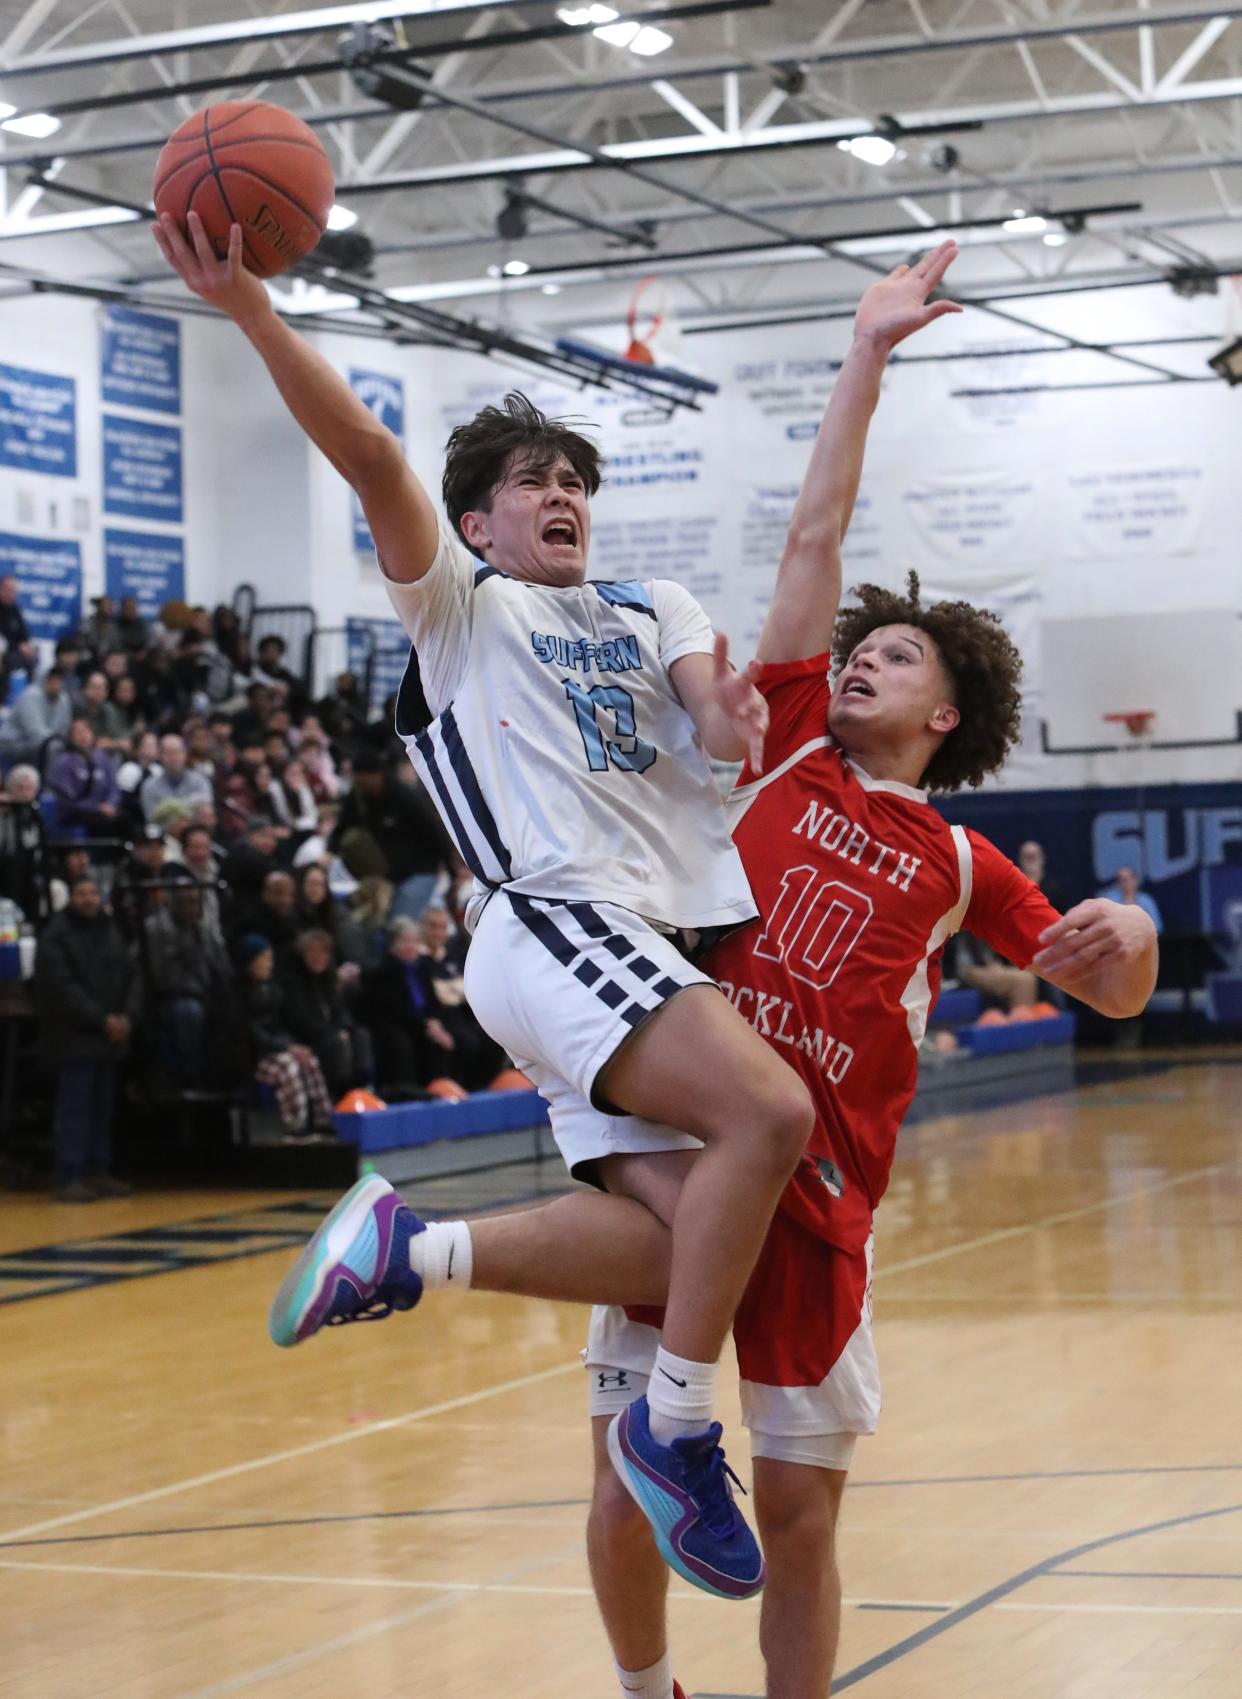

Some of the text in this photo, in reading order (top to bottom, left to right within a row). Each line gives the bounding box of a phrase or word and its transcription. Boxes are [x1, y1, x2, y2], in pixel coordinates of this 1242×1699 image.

[561, 678, 657, 774] 13
[791, 800, 923, 893] NORTH
[752, 863, 875, 991] 10
